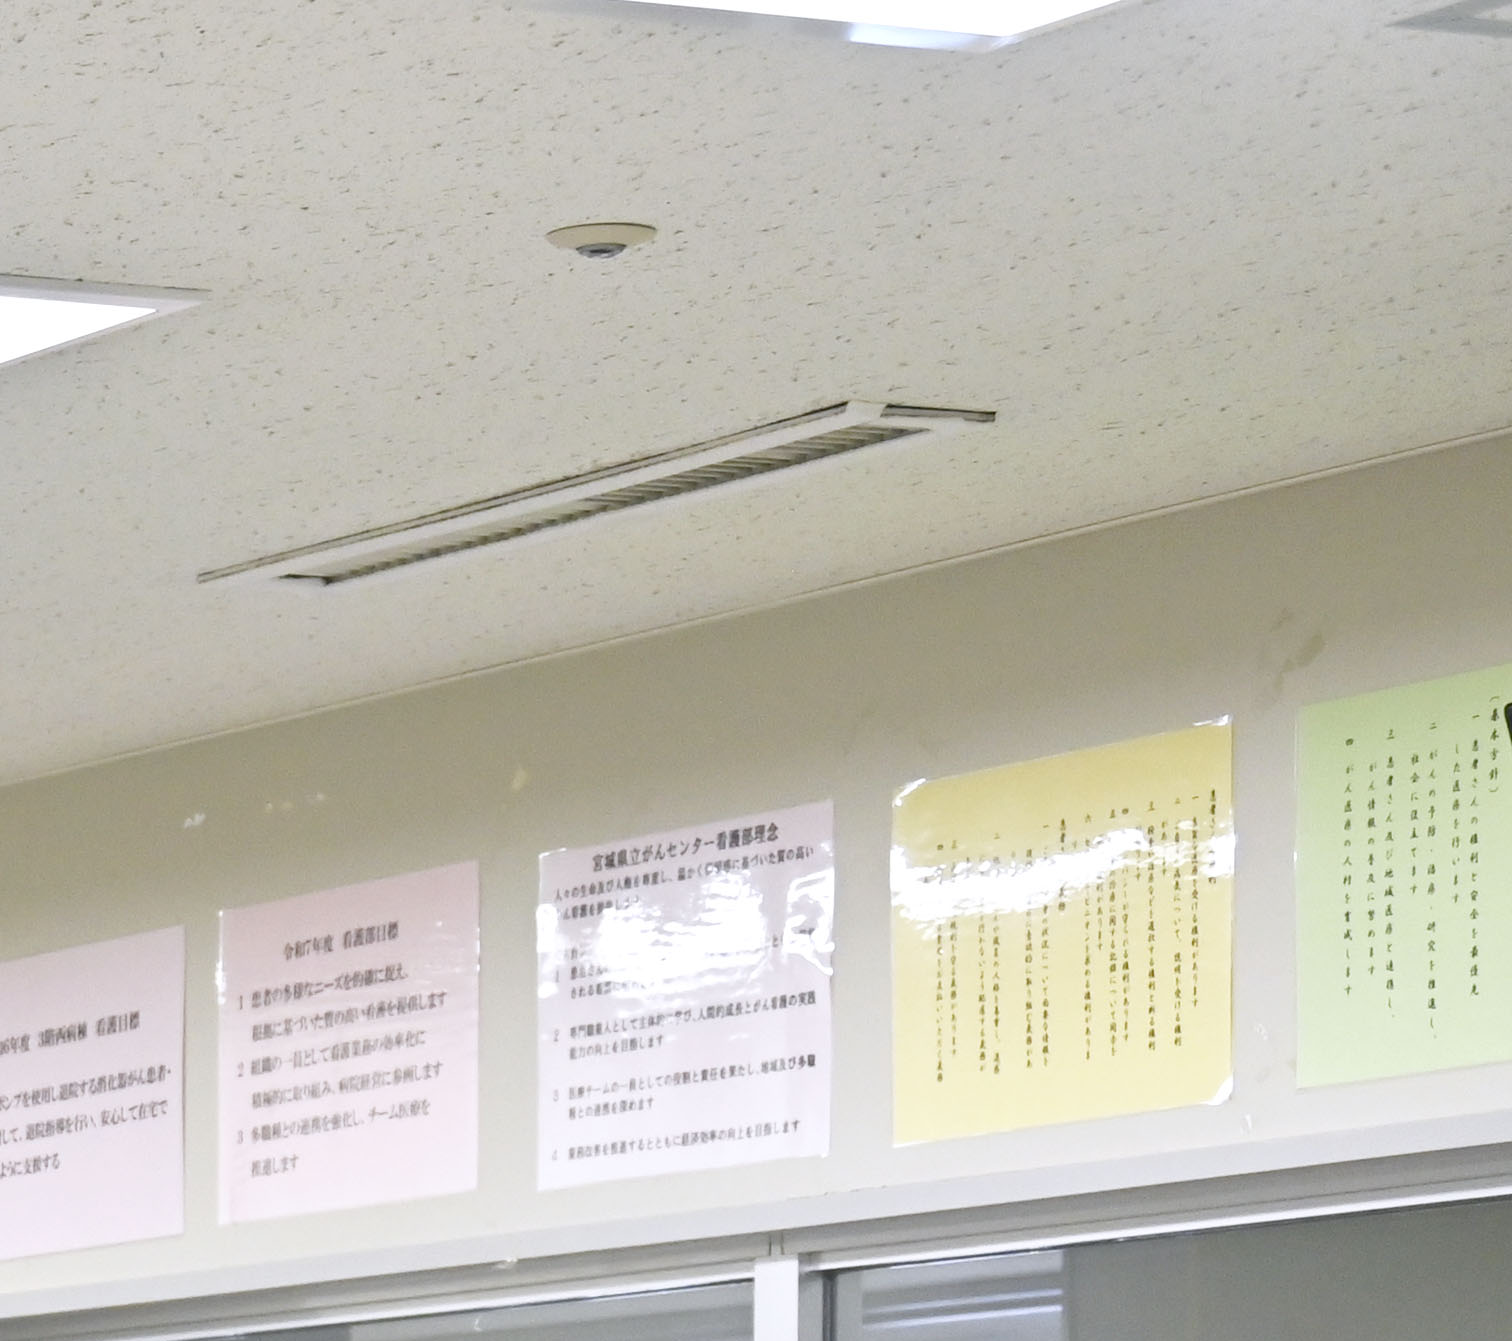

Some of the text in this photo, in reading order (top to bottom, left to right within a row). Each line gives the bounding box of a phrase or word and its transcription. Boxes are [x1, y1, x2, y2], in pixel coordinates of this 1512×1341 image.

[592, 822, 780, 872] 宮城県立がんセンター看護部理念
[343, 921, 400, 950] 看護部目標
[96, 1010, 141, 1037] 看護目標
